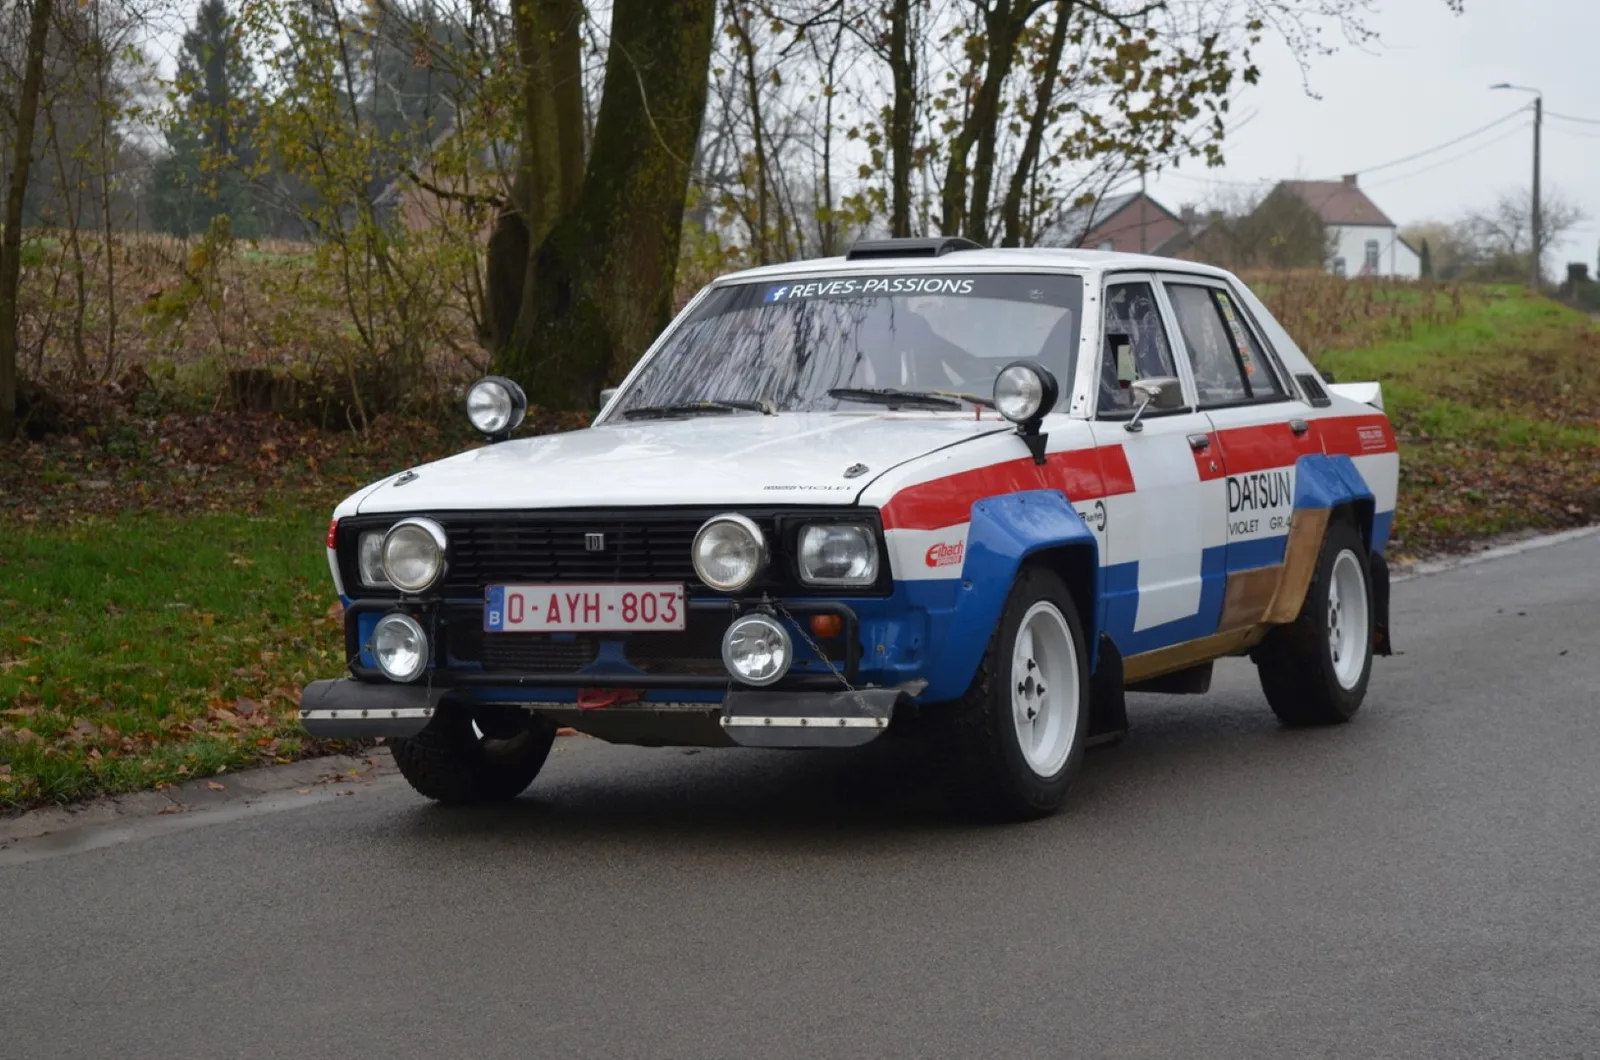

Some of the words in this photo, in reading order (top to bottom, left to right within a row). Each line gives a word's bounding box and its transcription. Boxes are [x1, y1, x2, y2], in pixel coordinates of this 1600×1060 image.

[788, 278, 975, 299] REVES-PASSIONS
[1227, 471, 1291, 513] DATSUN
[1228, 519, 1259, 536] VIOLET
[489, 611, 500, 625] B
